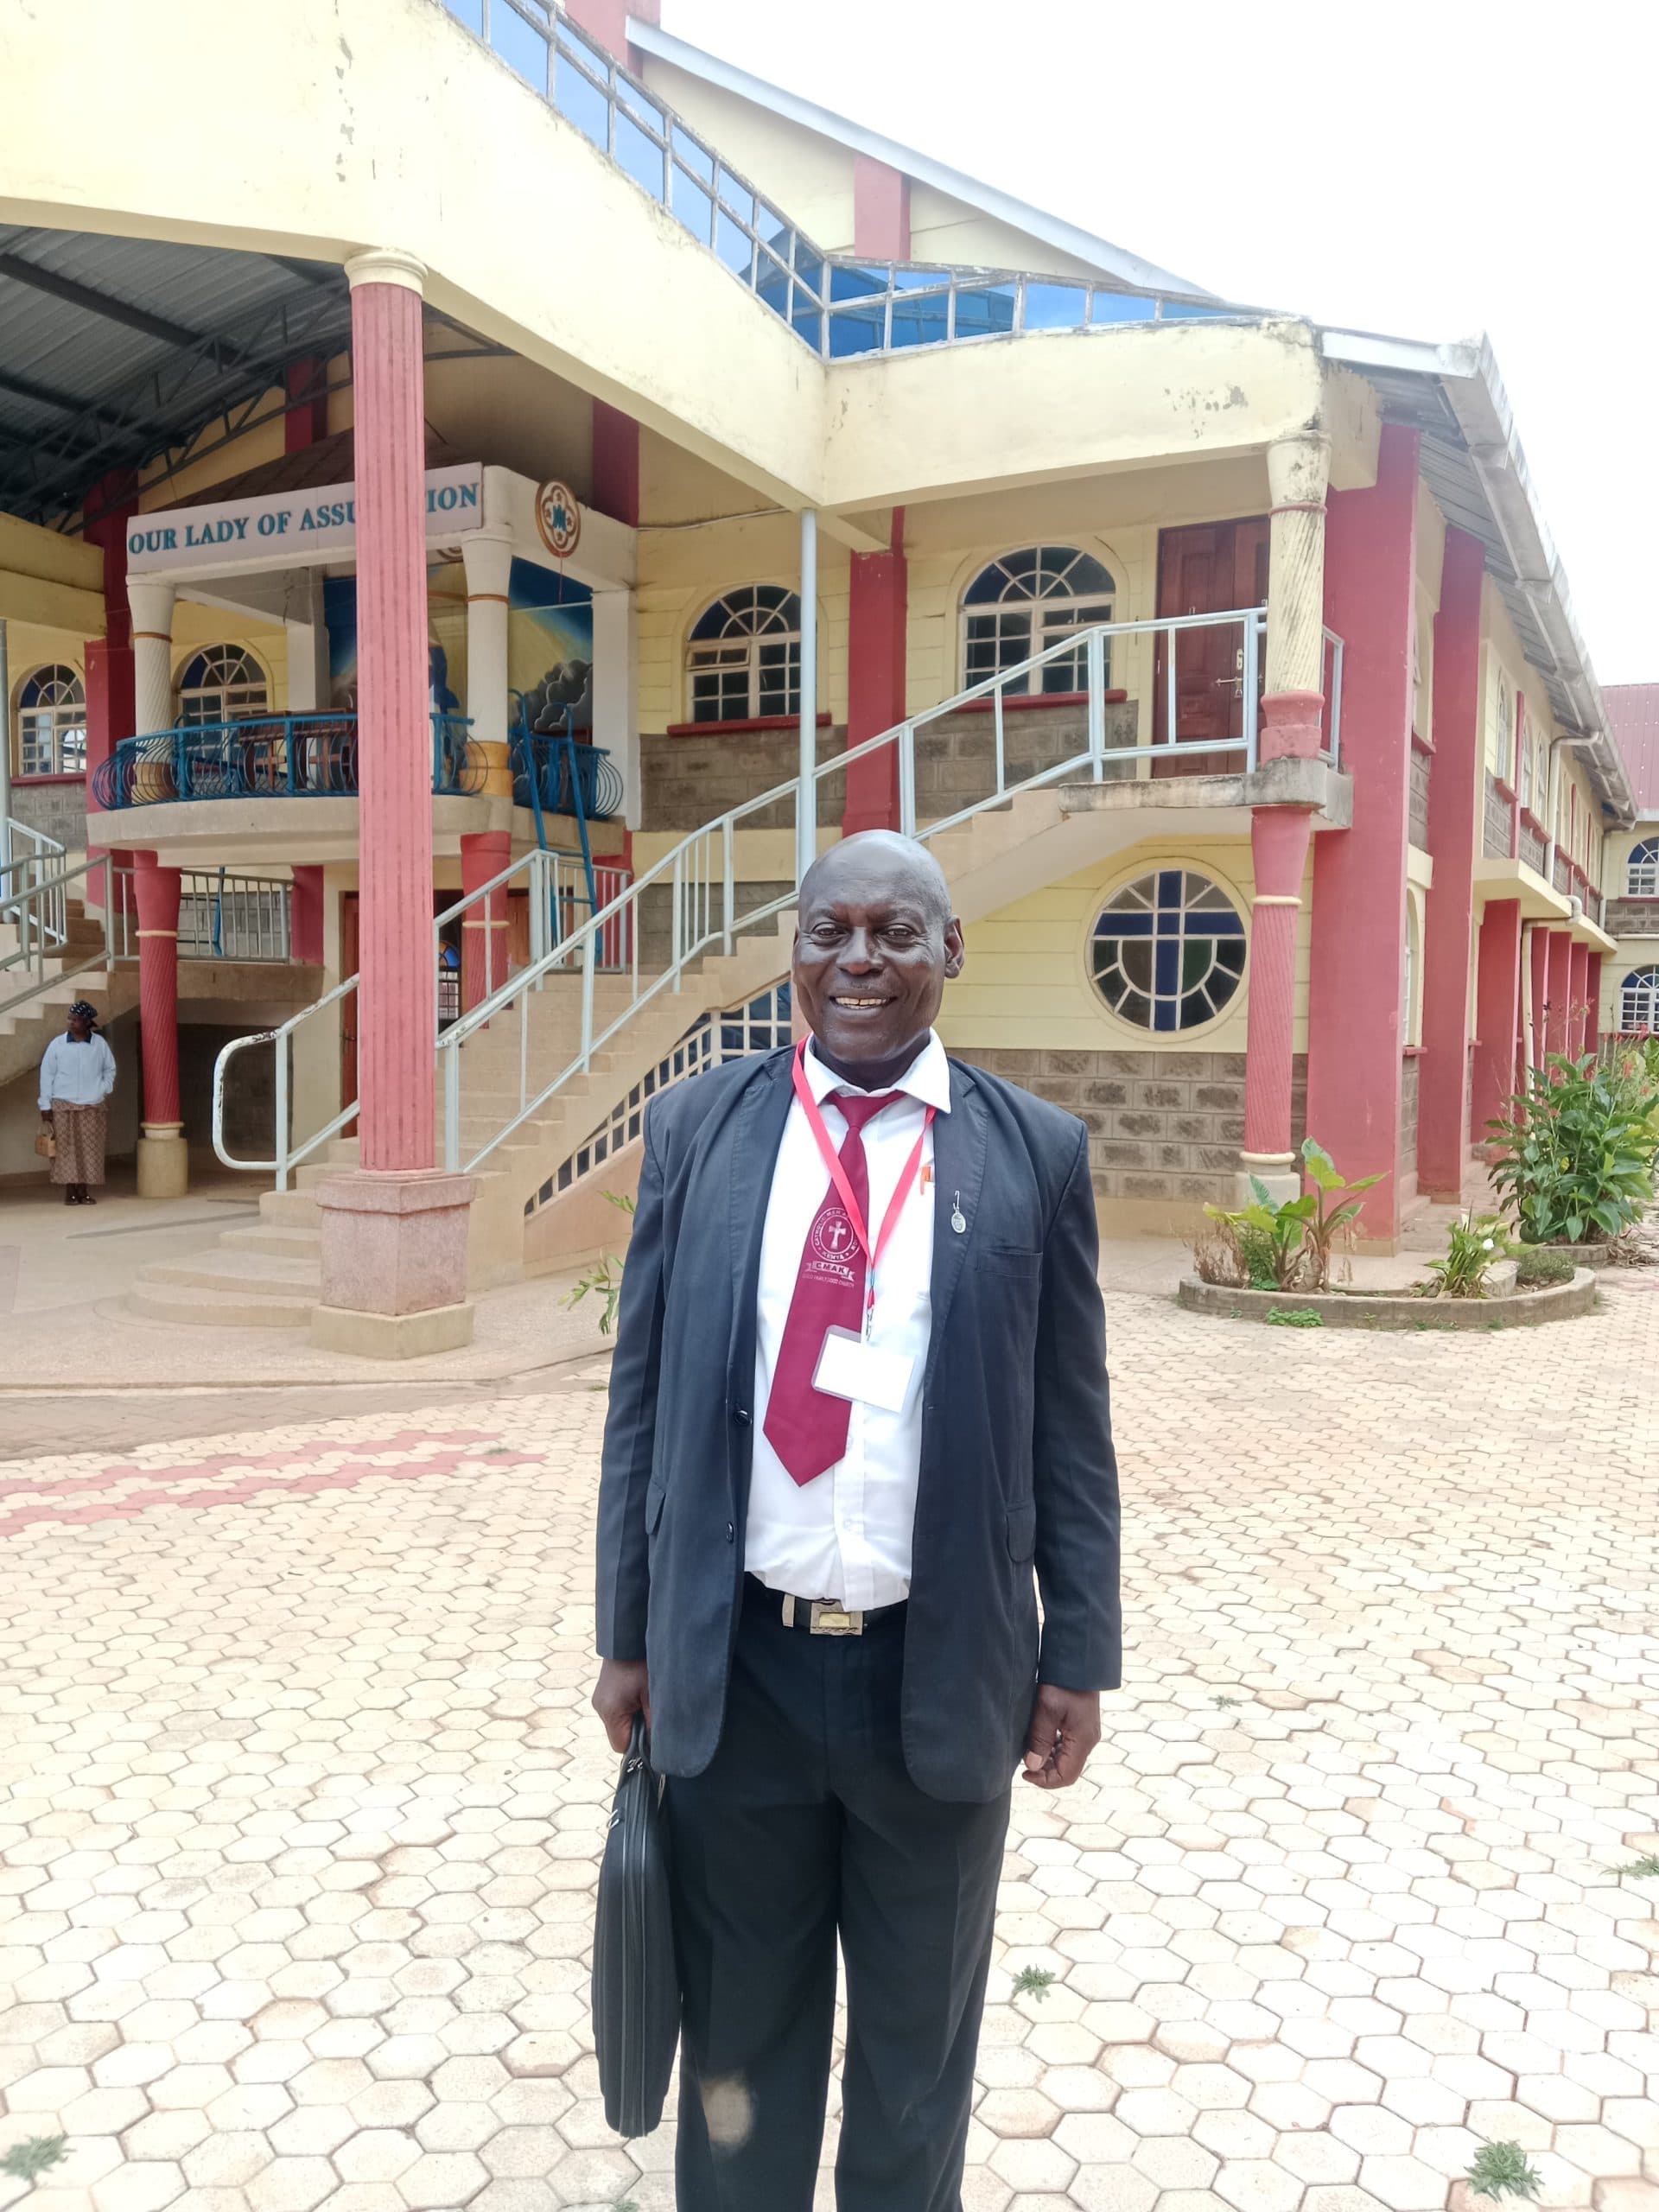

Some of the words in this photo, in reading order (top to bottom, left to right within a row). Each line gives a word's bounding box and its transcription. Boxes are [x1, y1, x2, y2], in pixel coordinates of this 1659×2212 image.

[128, 527, 178, 555] OUR
[185, 517, 250, 547] LADY
[257, 511, 291, 536] OF
[299, 482, 479, 531] ASSUION
[816, 1262, 845, 1274] CMAK
